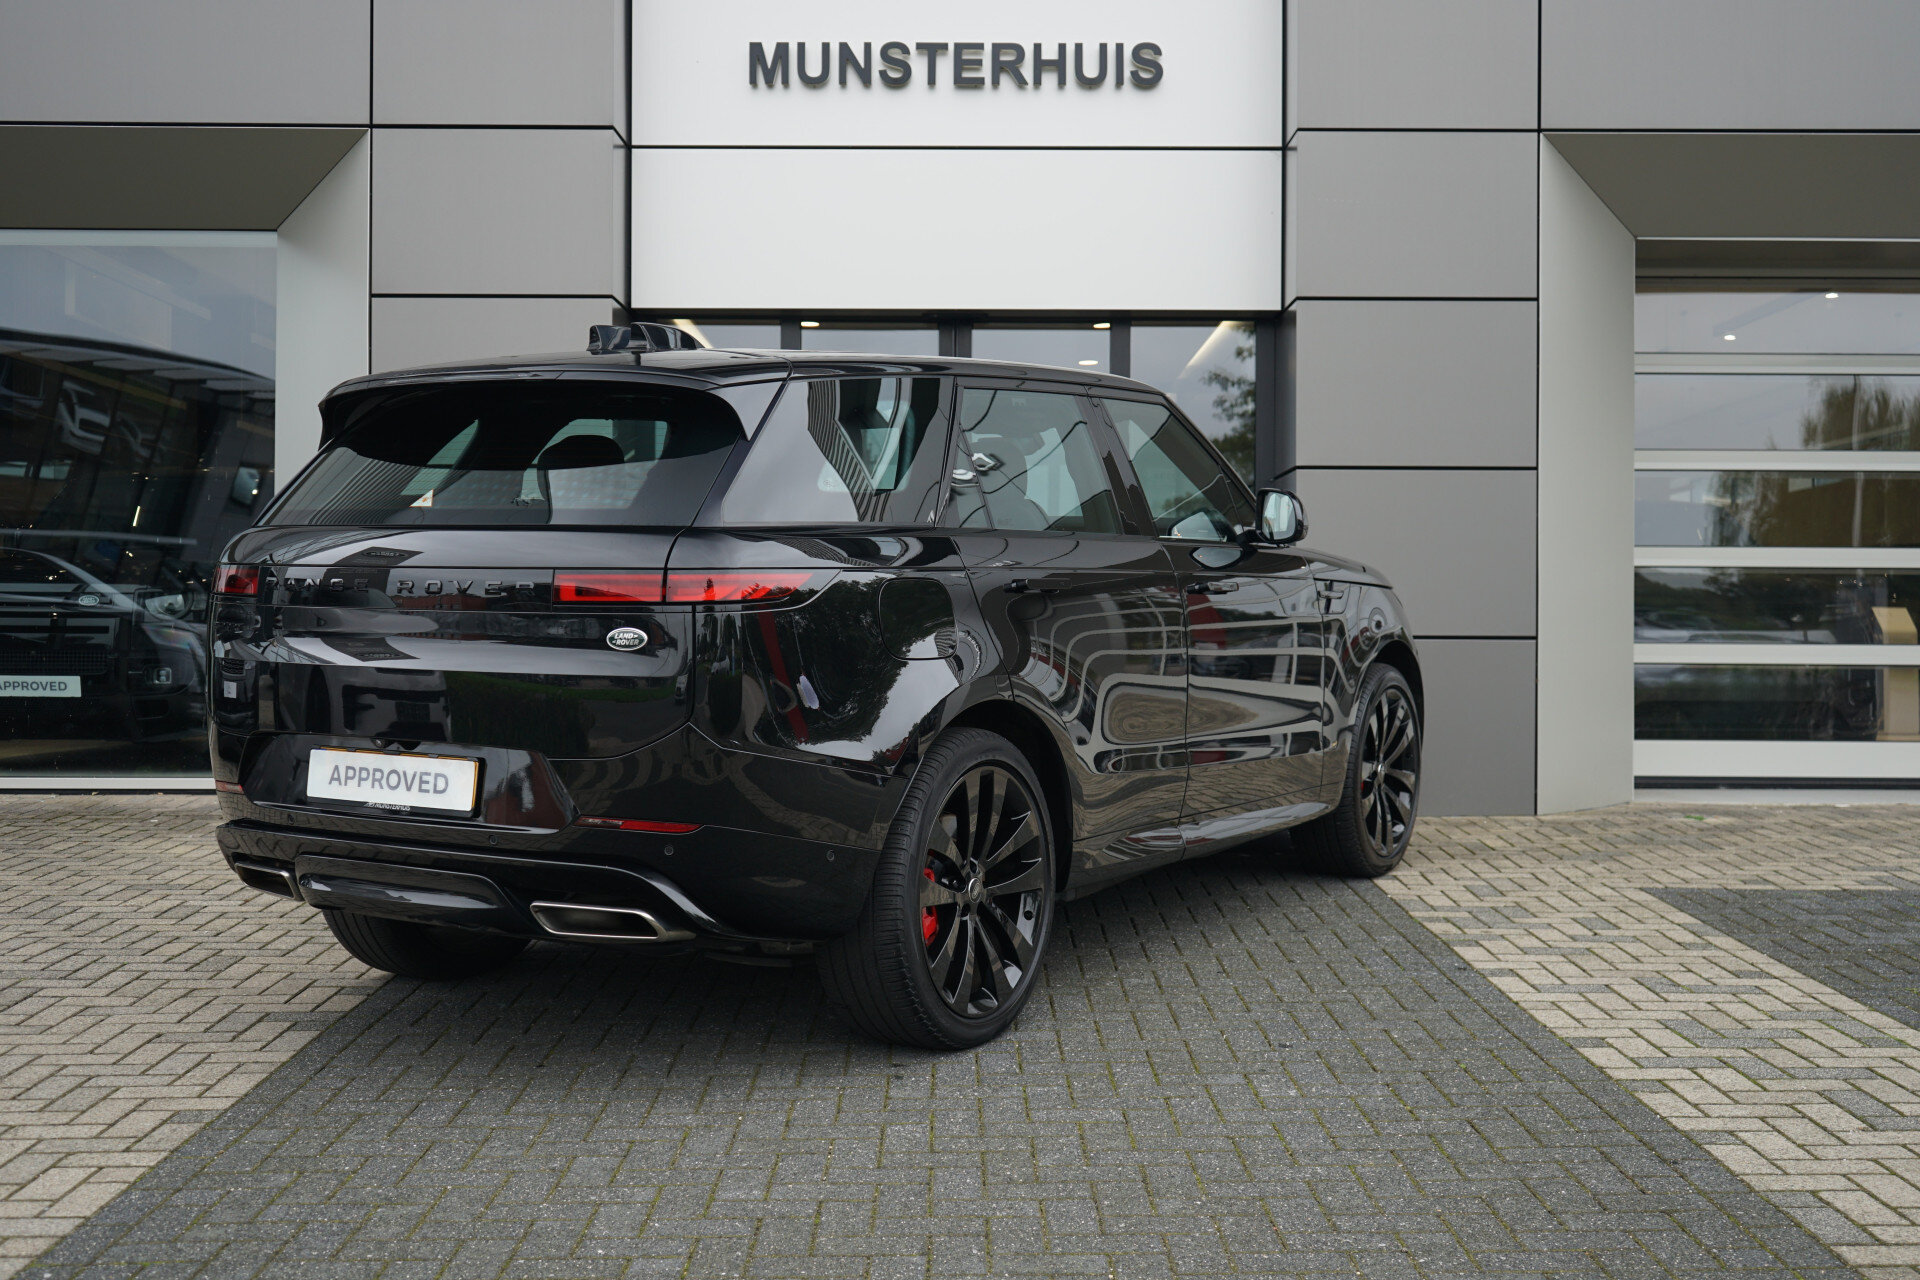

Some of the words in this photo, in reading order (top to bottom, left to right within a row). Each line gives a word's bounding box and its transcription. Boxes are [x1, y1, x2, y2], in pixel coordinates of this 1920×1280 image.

[749, 41, 1165, 88] MUNSTERHUIS
[396, 579, 536, 598] ROVER
[614, 632, 634, 640] LAND
[328, 764, 449, 795] APPROVED
